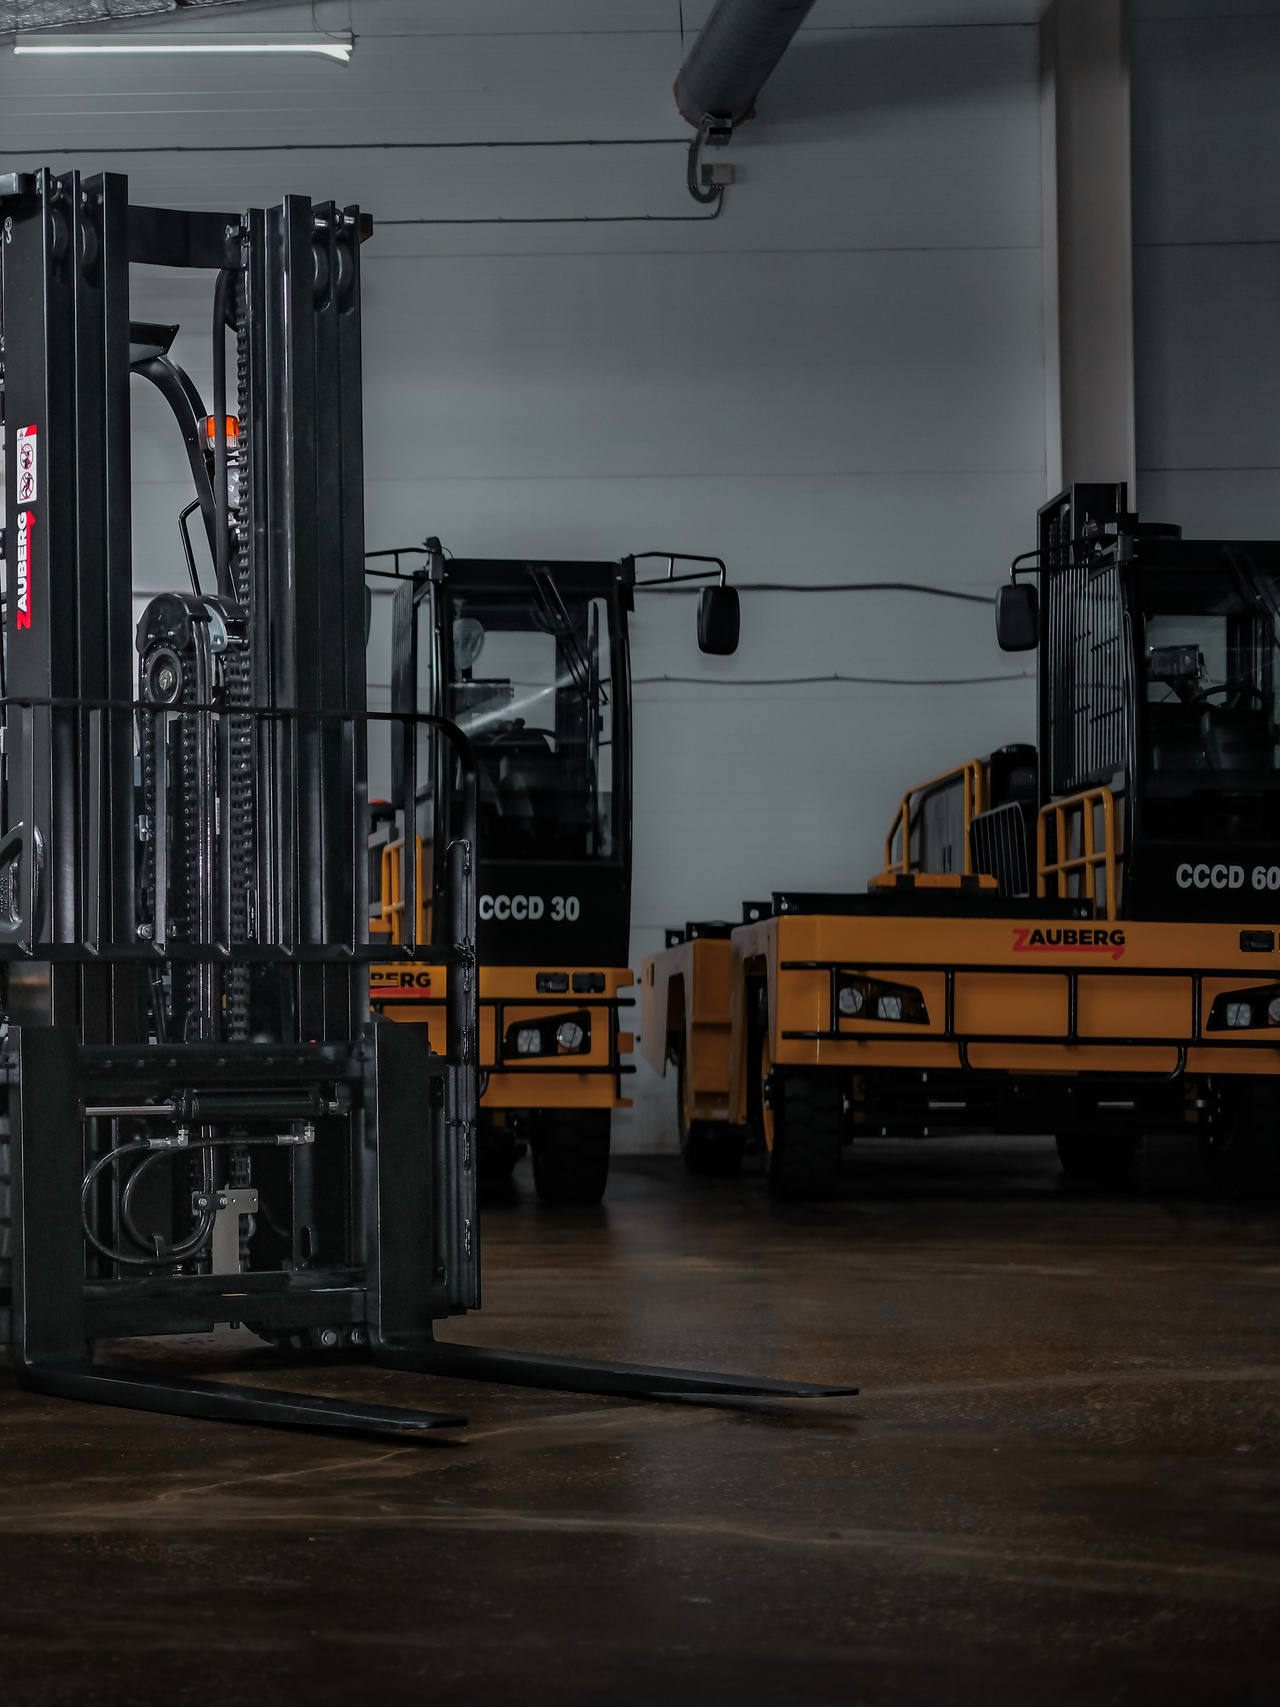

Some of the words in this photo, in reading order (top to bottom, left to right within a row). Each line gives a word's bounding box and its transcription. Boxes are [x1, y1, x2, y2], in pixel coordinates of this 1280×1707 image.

[16, 510, 33, 630] ZAUBERG
[1176, 863, 1245, 889] CCCD
[1251, 865, 1280, 890] 60
[479, 894, 545, 921] CCCD
[551, 895, 580, 922] 30
[1013, 928, 1125, 954] ZAUBERG
[370, 972, 431, 988] BERG
